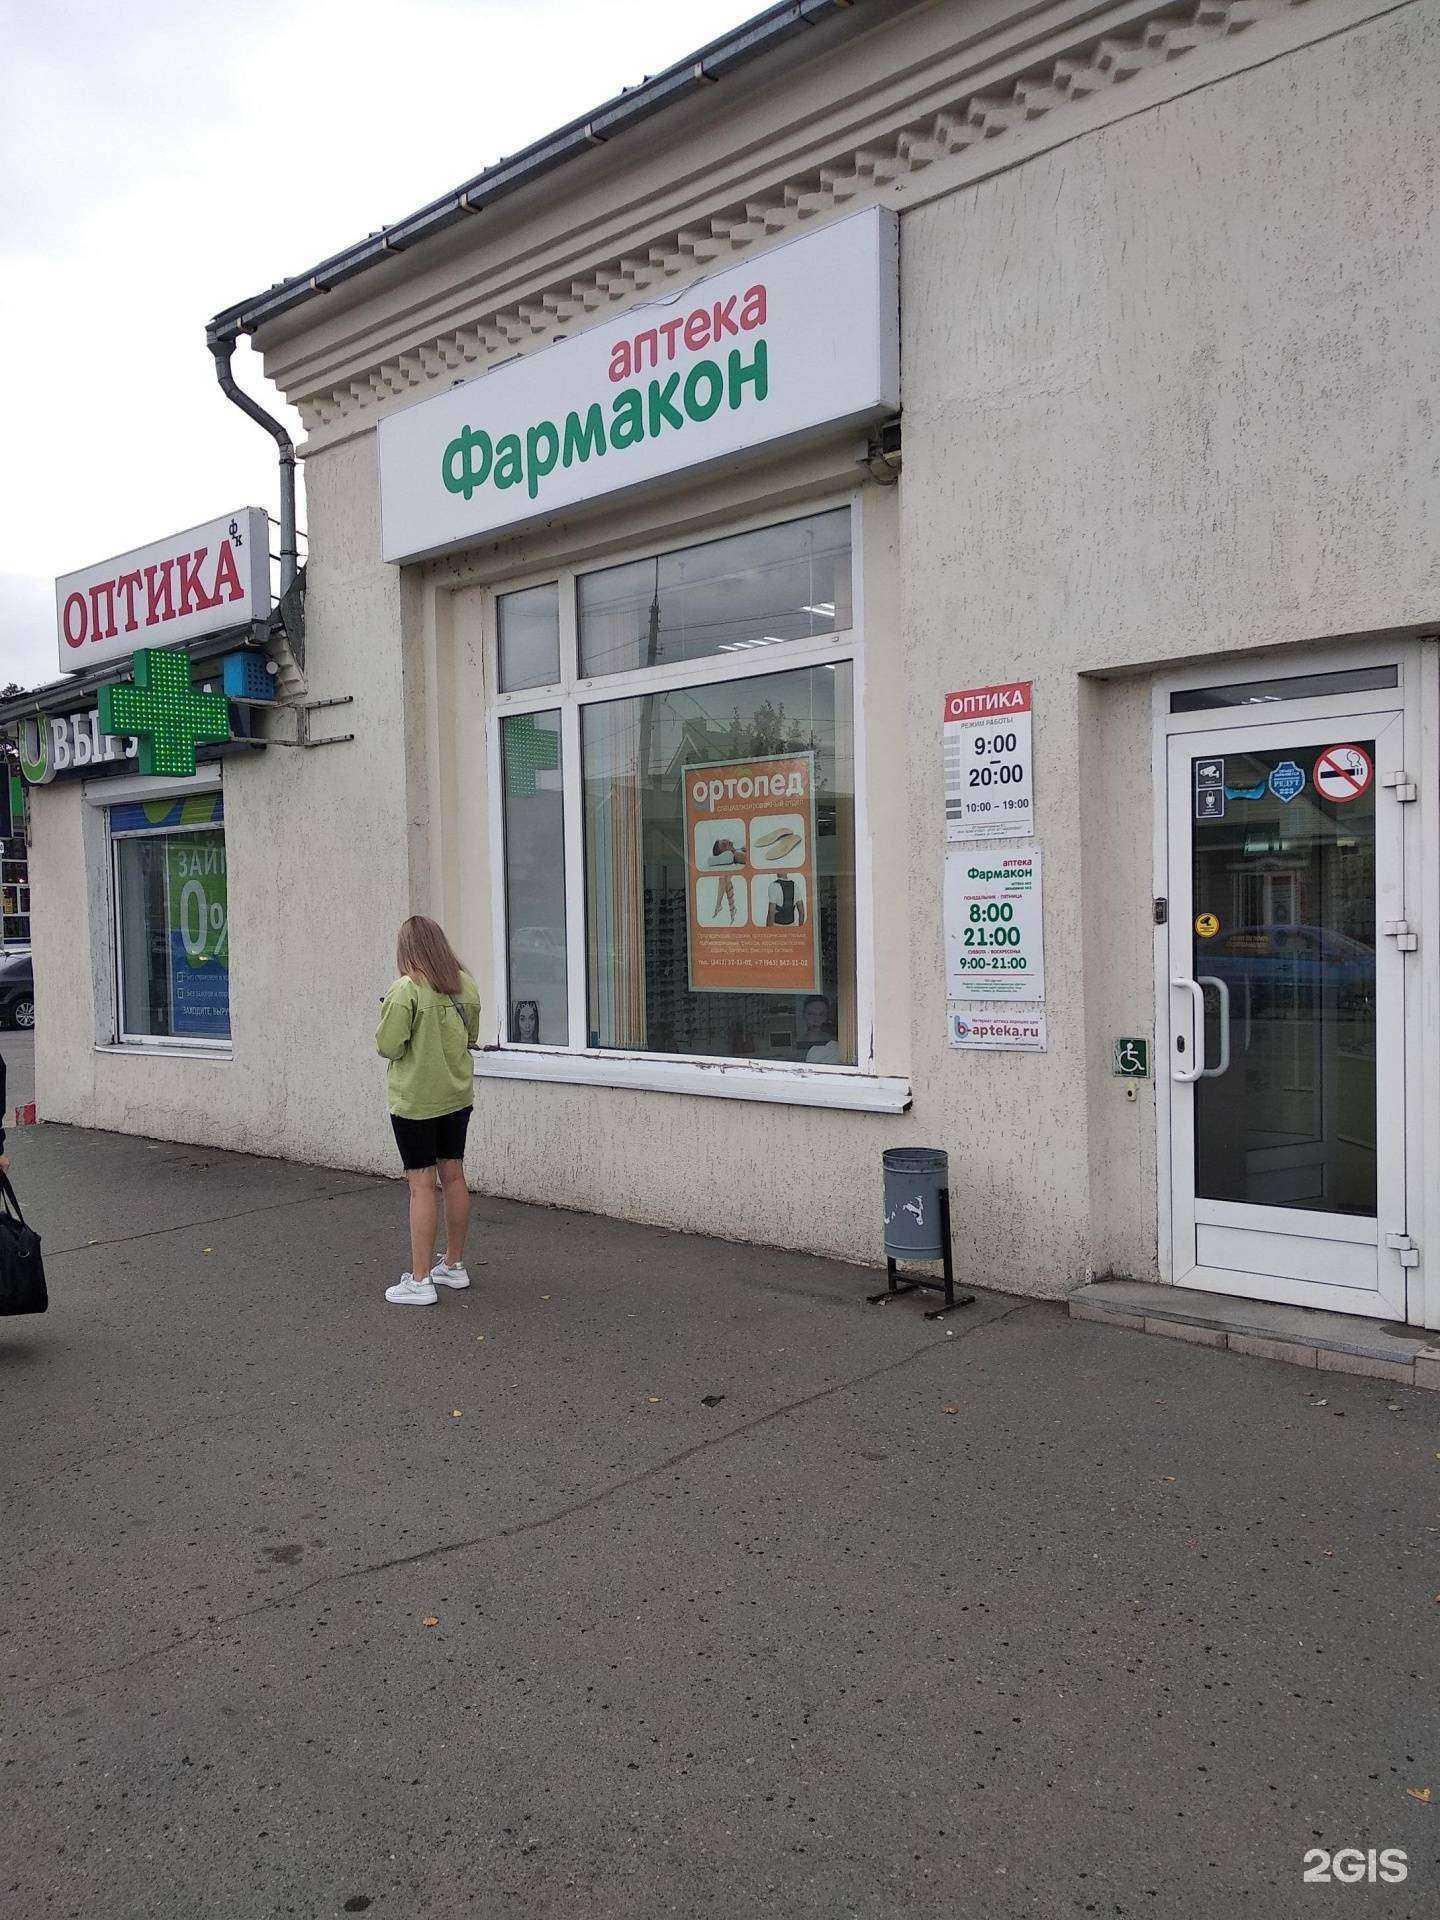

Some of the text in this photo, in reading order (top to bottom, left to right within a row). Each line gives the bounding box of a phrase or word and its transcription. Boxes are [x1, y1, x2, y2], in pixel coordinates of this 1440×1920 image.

[608, 283, 768, 382] аптека
[441, 339, 769, 500] Фармакон
[63, 539, 245, 648] ОПТИКА
[950, 690, 1024, 714] ОПТИКА
[974, 733, 1017, 755] 9:00
[969, 764, 1023, 787] 20:00
[692, 772, 804, 813] ортопед
[966, 802, 991, 812] 10:00
[1003, 799, 1029, 809] 19:00
[1002, 859, 1032, 867] аптека
[967, 867, 1033, 882] Фармакон
[969, 902, 1013, 922] 8:00
[963, 926, 1021, 946] 21:00
